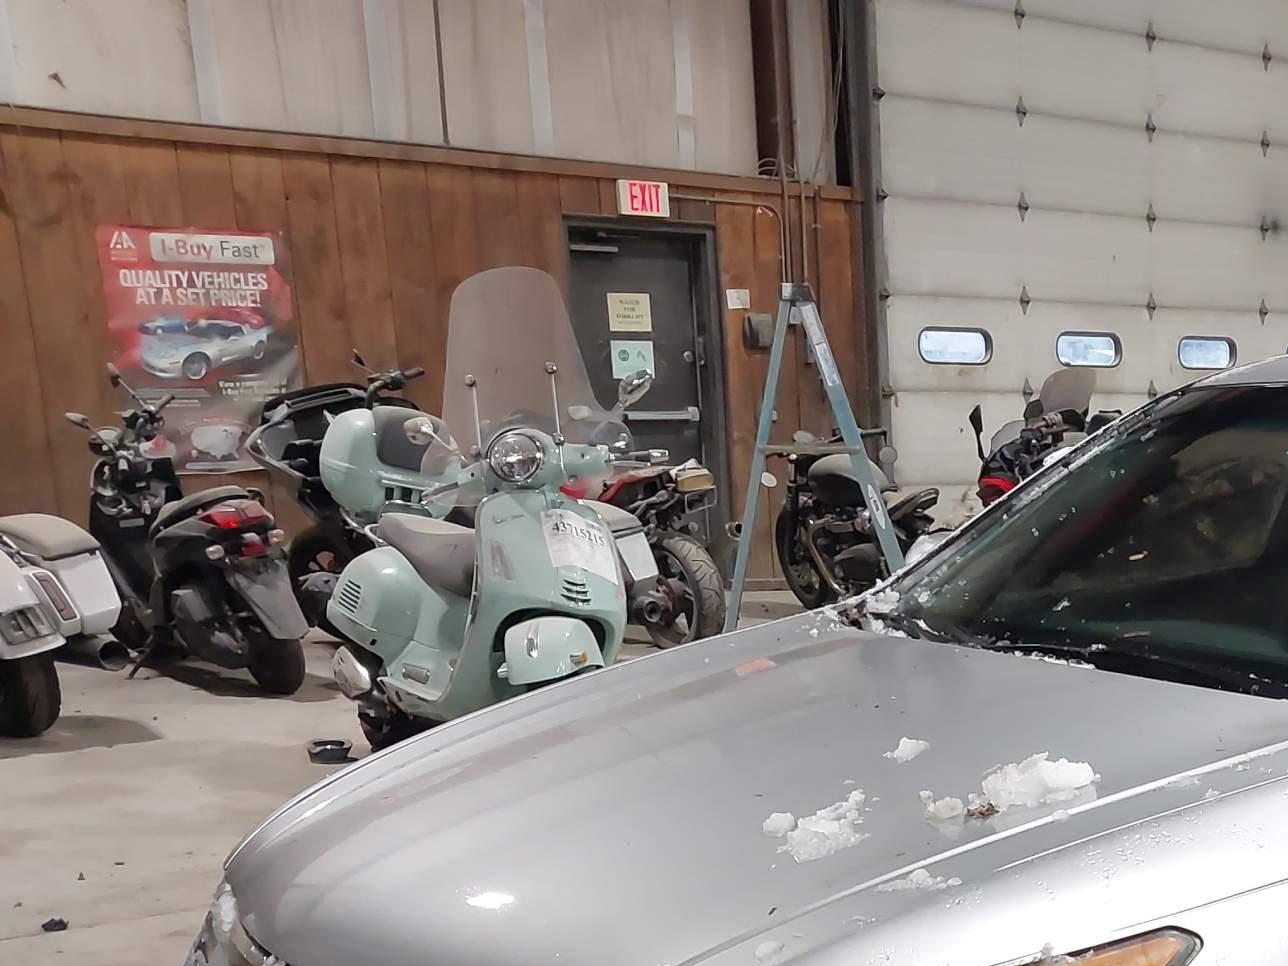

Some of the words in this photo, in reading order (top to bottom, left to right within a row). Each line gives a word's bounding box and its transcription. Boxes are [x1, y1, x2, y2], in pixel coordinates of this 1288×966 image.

[628, 182, 661, 213] EXIT
[161, 239, 213, 261] I-Buy
[219, 240, 260, 259] Fast
[119, 268, 190, 288] QUALITY
[191, 270, 269, 291] VEHICLES
[135, 287, 158, 306] AT
[160, 288, 175, 306] A
[175, 289, 207, 307] SET
[209, 290, 262, 308] PRICE!
[551, 521, 606, 547] 43715215
